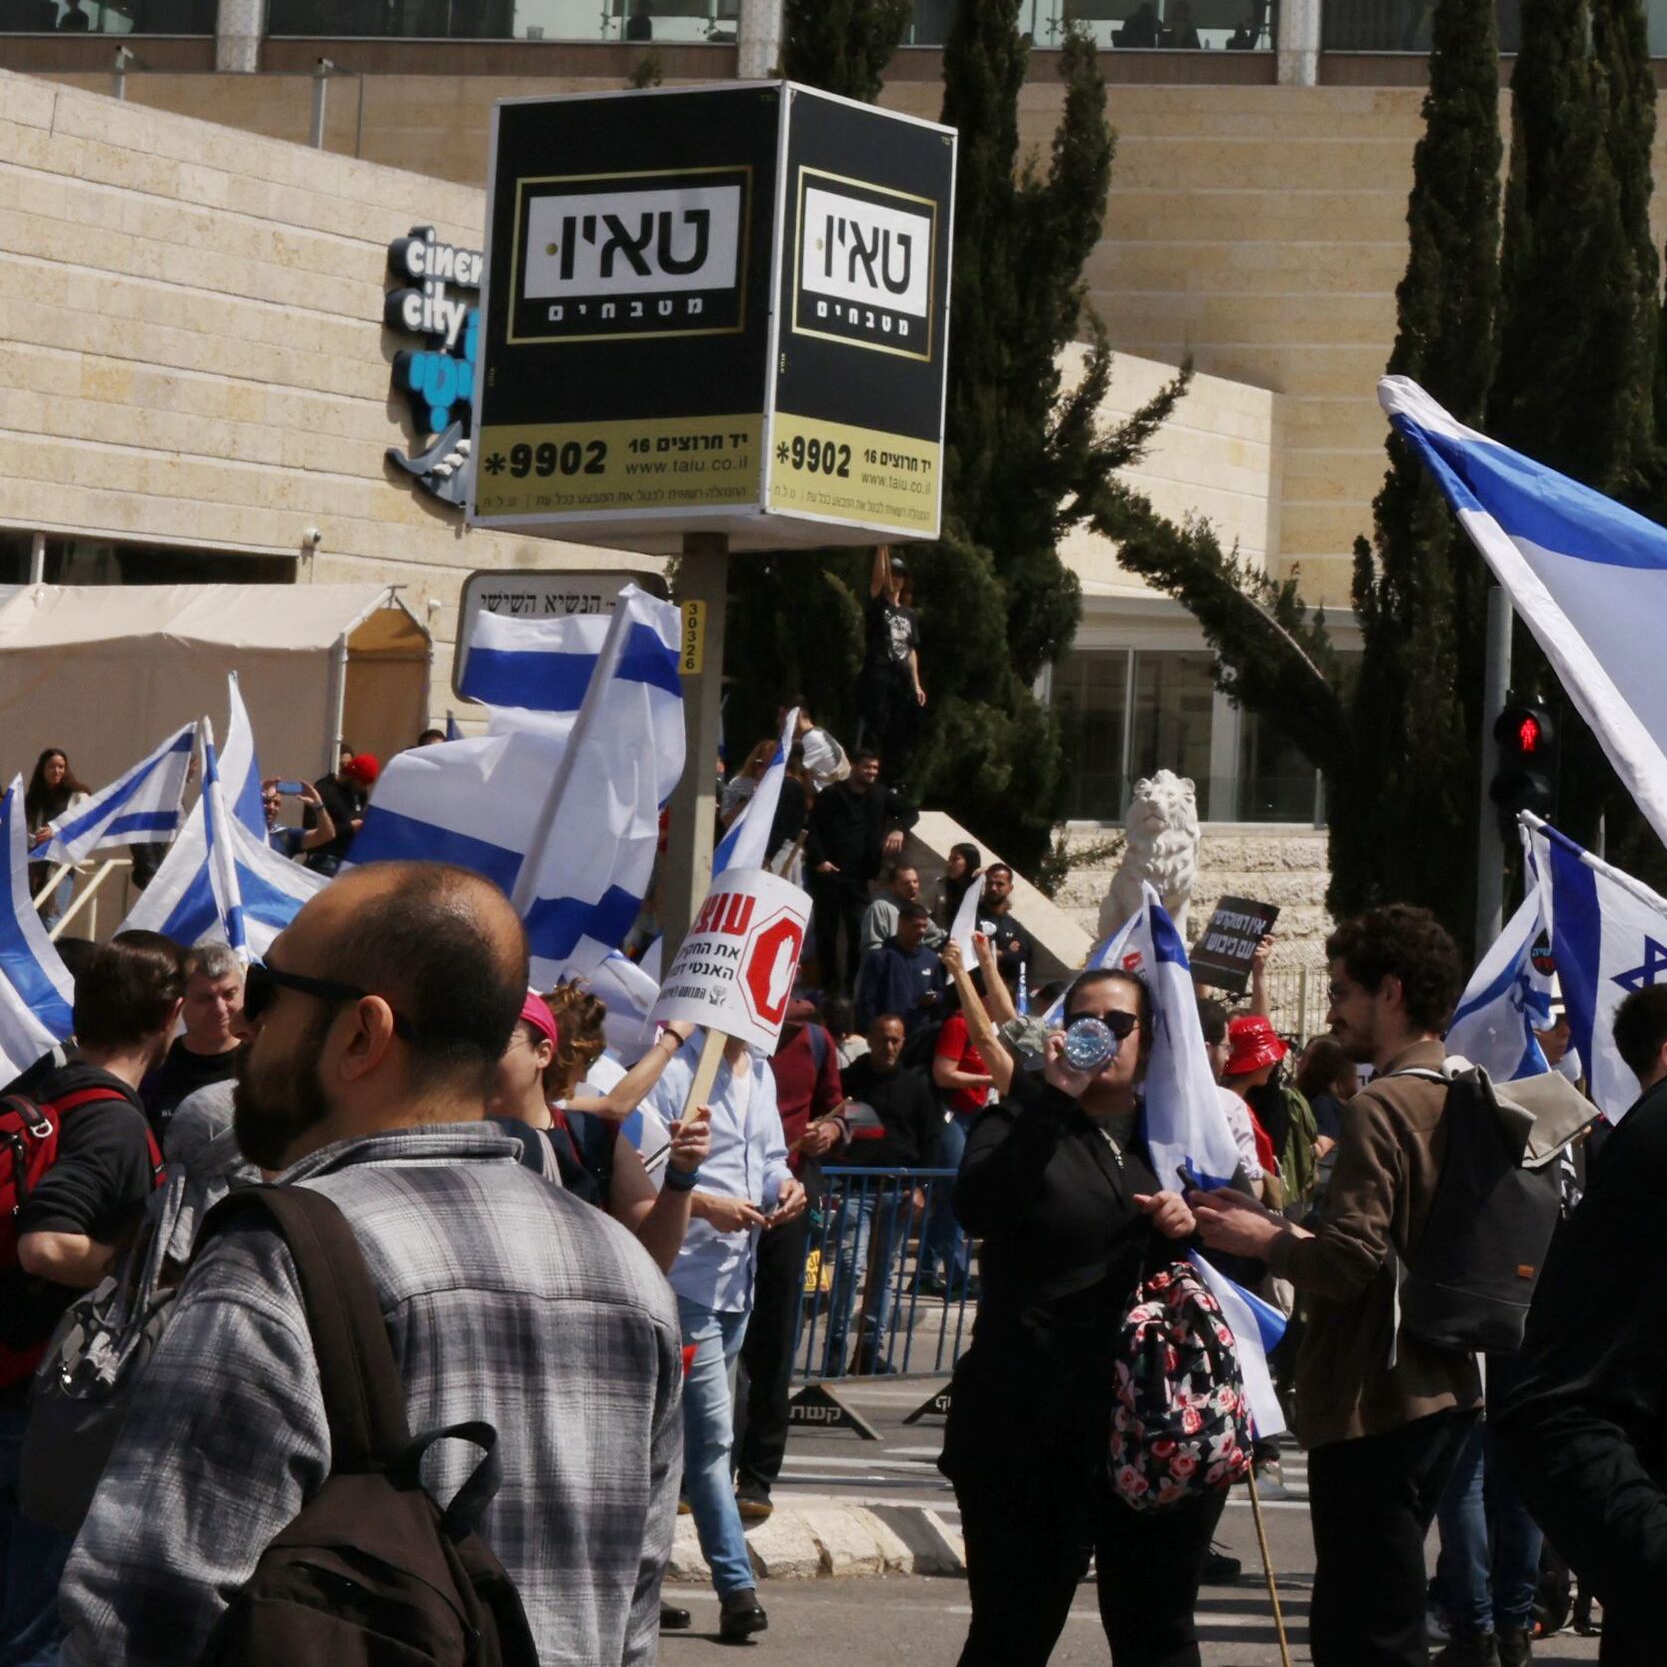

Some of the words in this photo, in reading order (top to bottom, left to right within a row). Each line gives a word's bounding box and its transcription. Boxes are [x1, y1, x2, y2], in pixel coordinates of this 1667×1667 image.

[403, 281, 466, 347] city
[548, 297, 703, 321] מטבחים
[817, 300, 909, 336] מטבחים
[628, 438, 650, 453] 16
[656, 434, 723, 452] חרוצים
[728, 433, 749, 450] יד
[626, 455, 748, 476] www.taiu.co.il
[863, 449, 877, 465] 16
[880, 451, 918, 472] חרוצים
[920, 459, 932, 474] יד
[861, 472, 931, 495] www.taiu.co.il
[686, 603, 698, 670] 30326
[714, 943, 741, 960] את
[688, 962, 735, 981] האנטי
[789, 1405, 841, 1424] קשת
